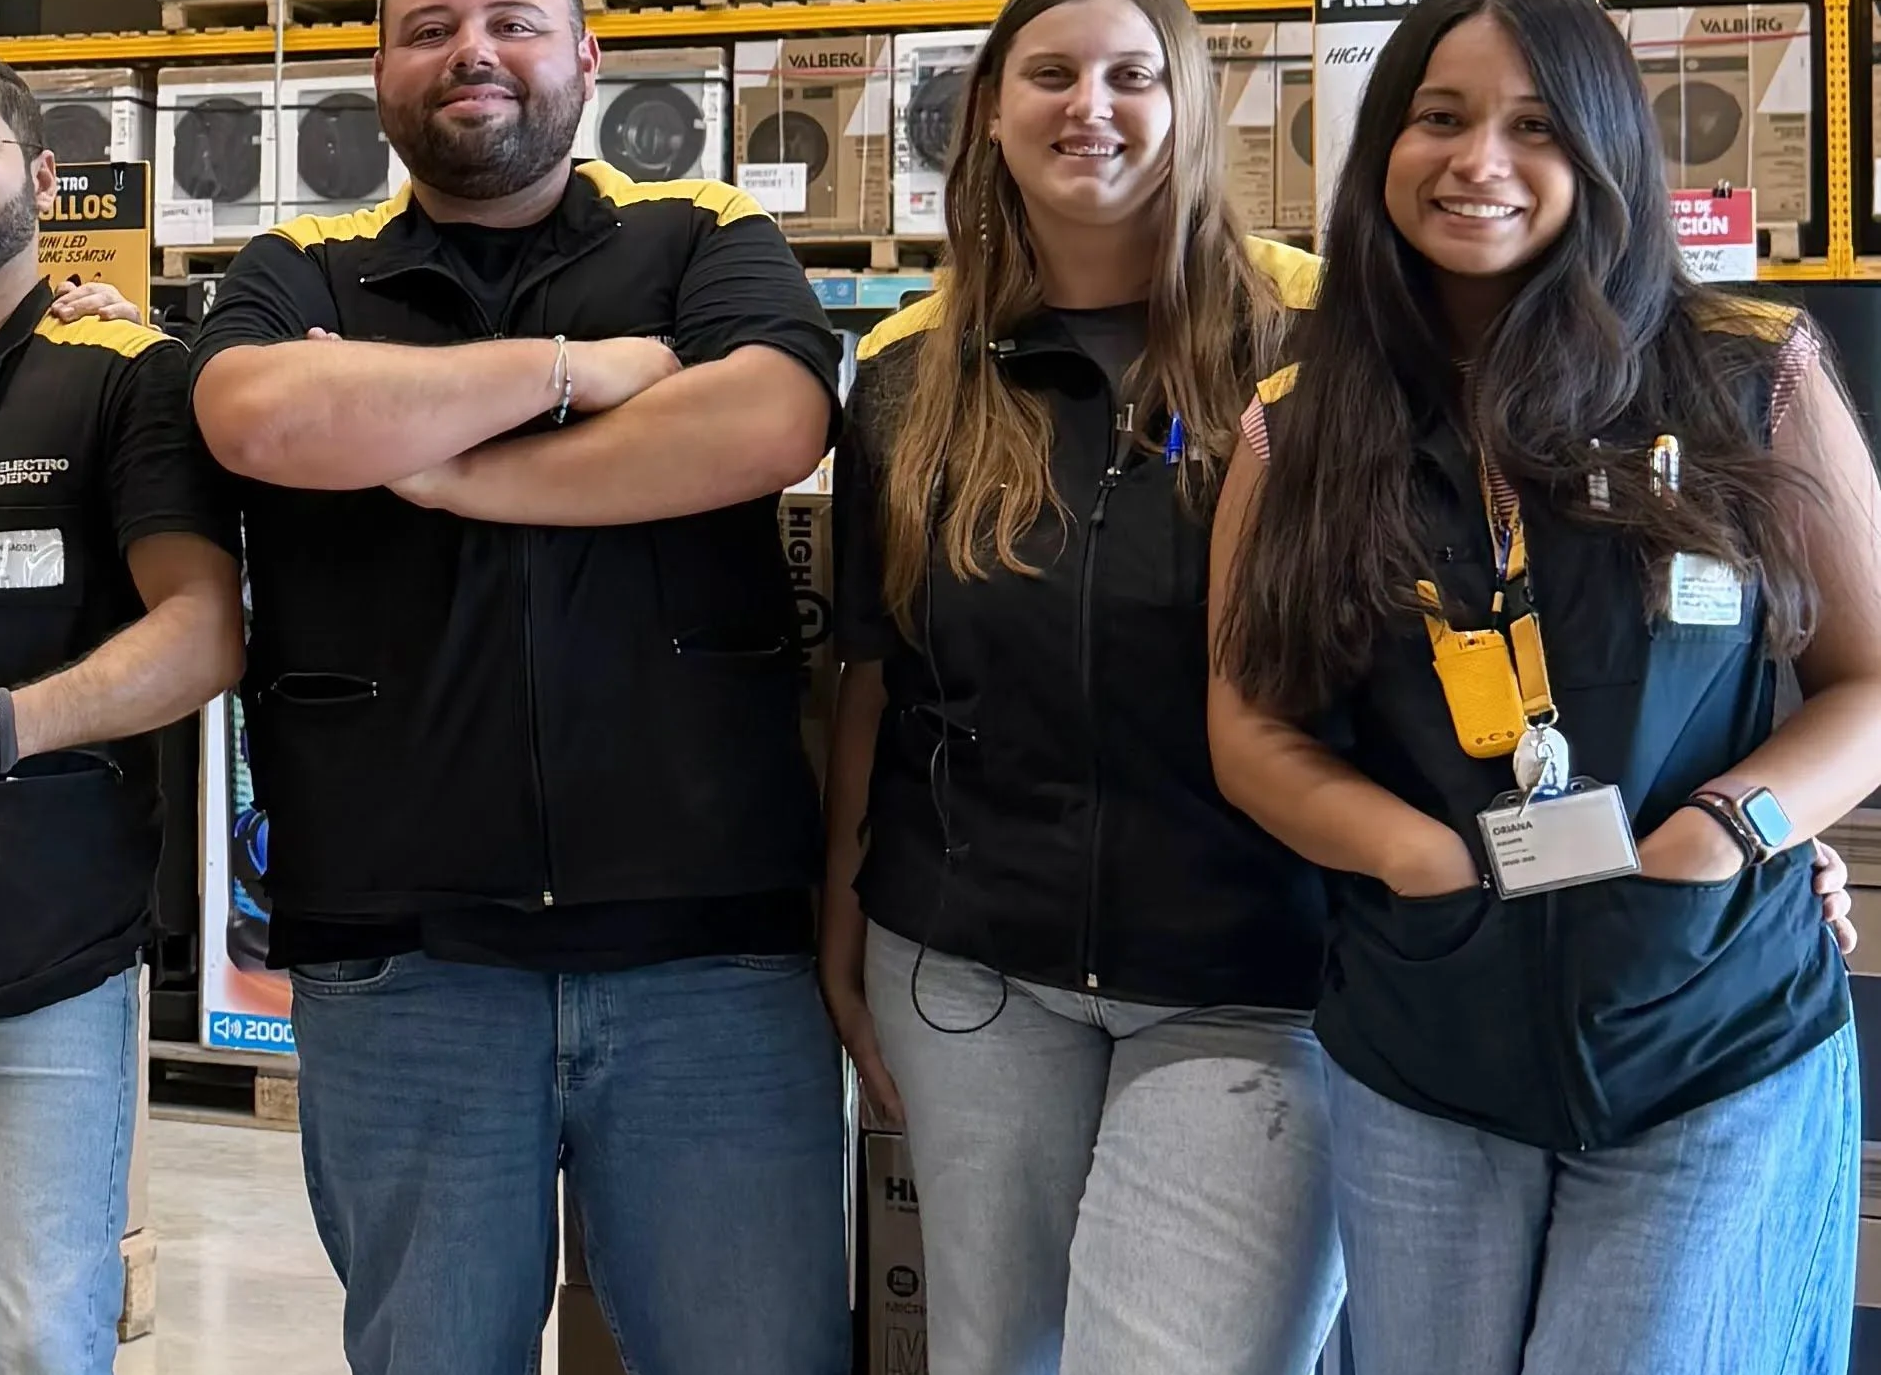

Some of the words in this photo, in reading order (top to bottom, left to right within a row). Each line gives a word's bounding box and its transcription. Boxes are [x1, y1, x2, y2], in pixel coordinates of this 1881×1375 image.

[788, 52, 863, 68] VALBERG
[1324, 46, 1375, 65] HIGH
[63, 235, 88, 248] LED
